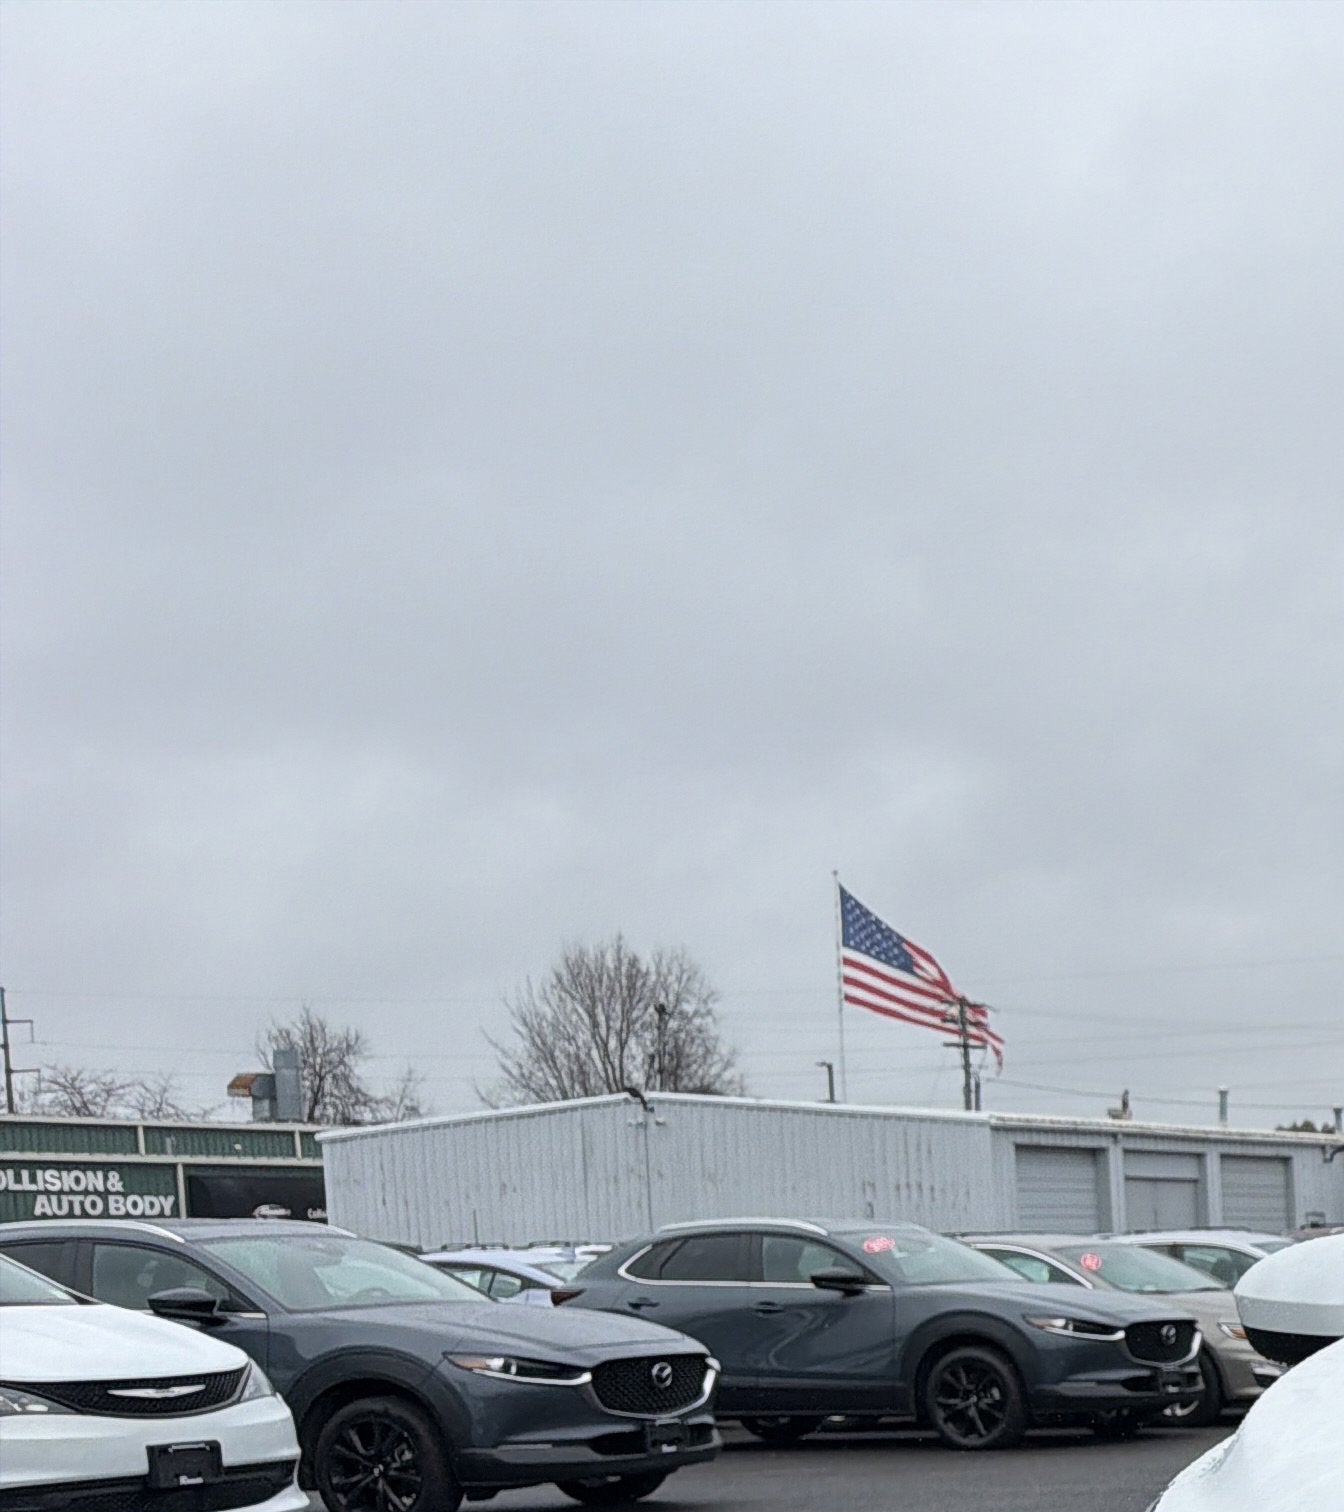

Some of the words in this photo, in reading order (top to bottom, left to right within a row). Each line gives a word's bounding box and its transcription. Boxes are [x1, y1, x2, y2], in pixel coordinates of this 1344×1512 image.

[106, 1170, 125, 1192] &
[34, 1194, 104, 1216] AUTO
[108, 1194, 175, 1217] BODY
